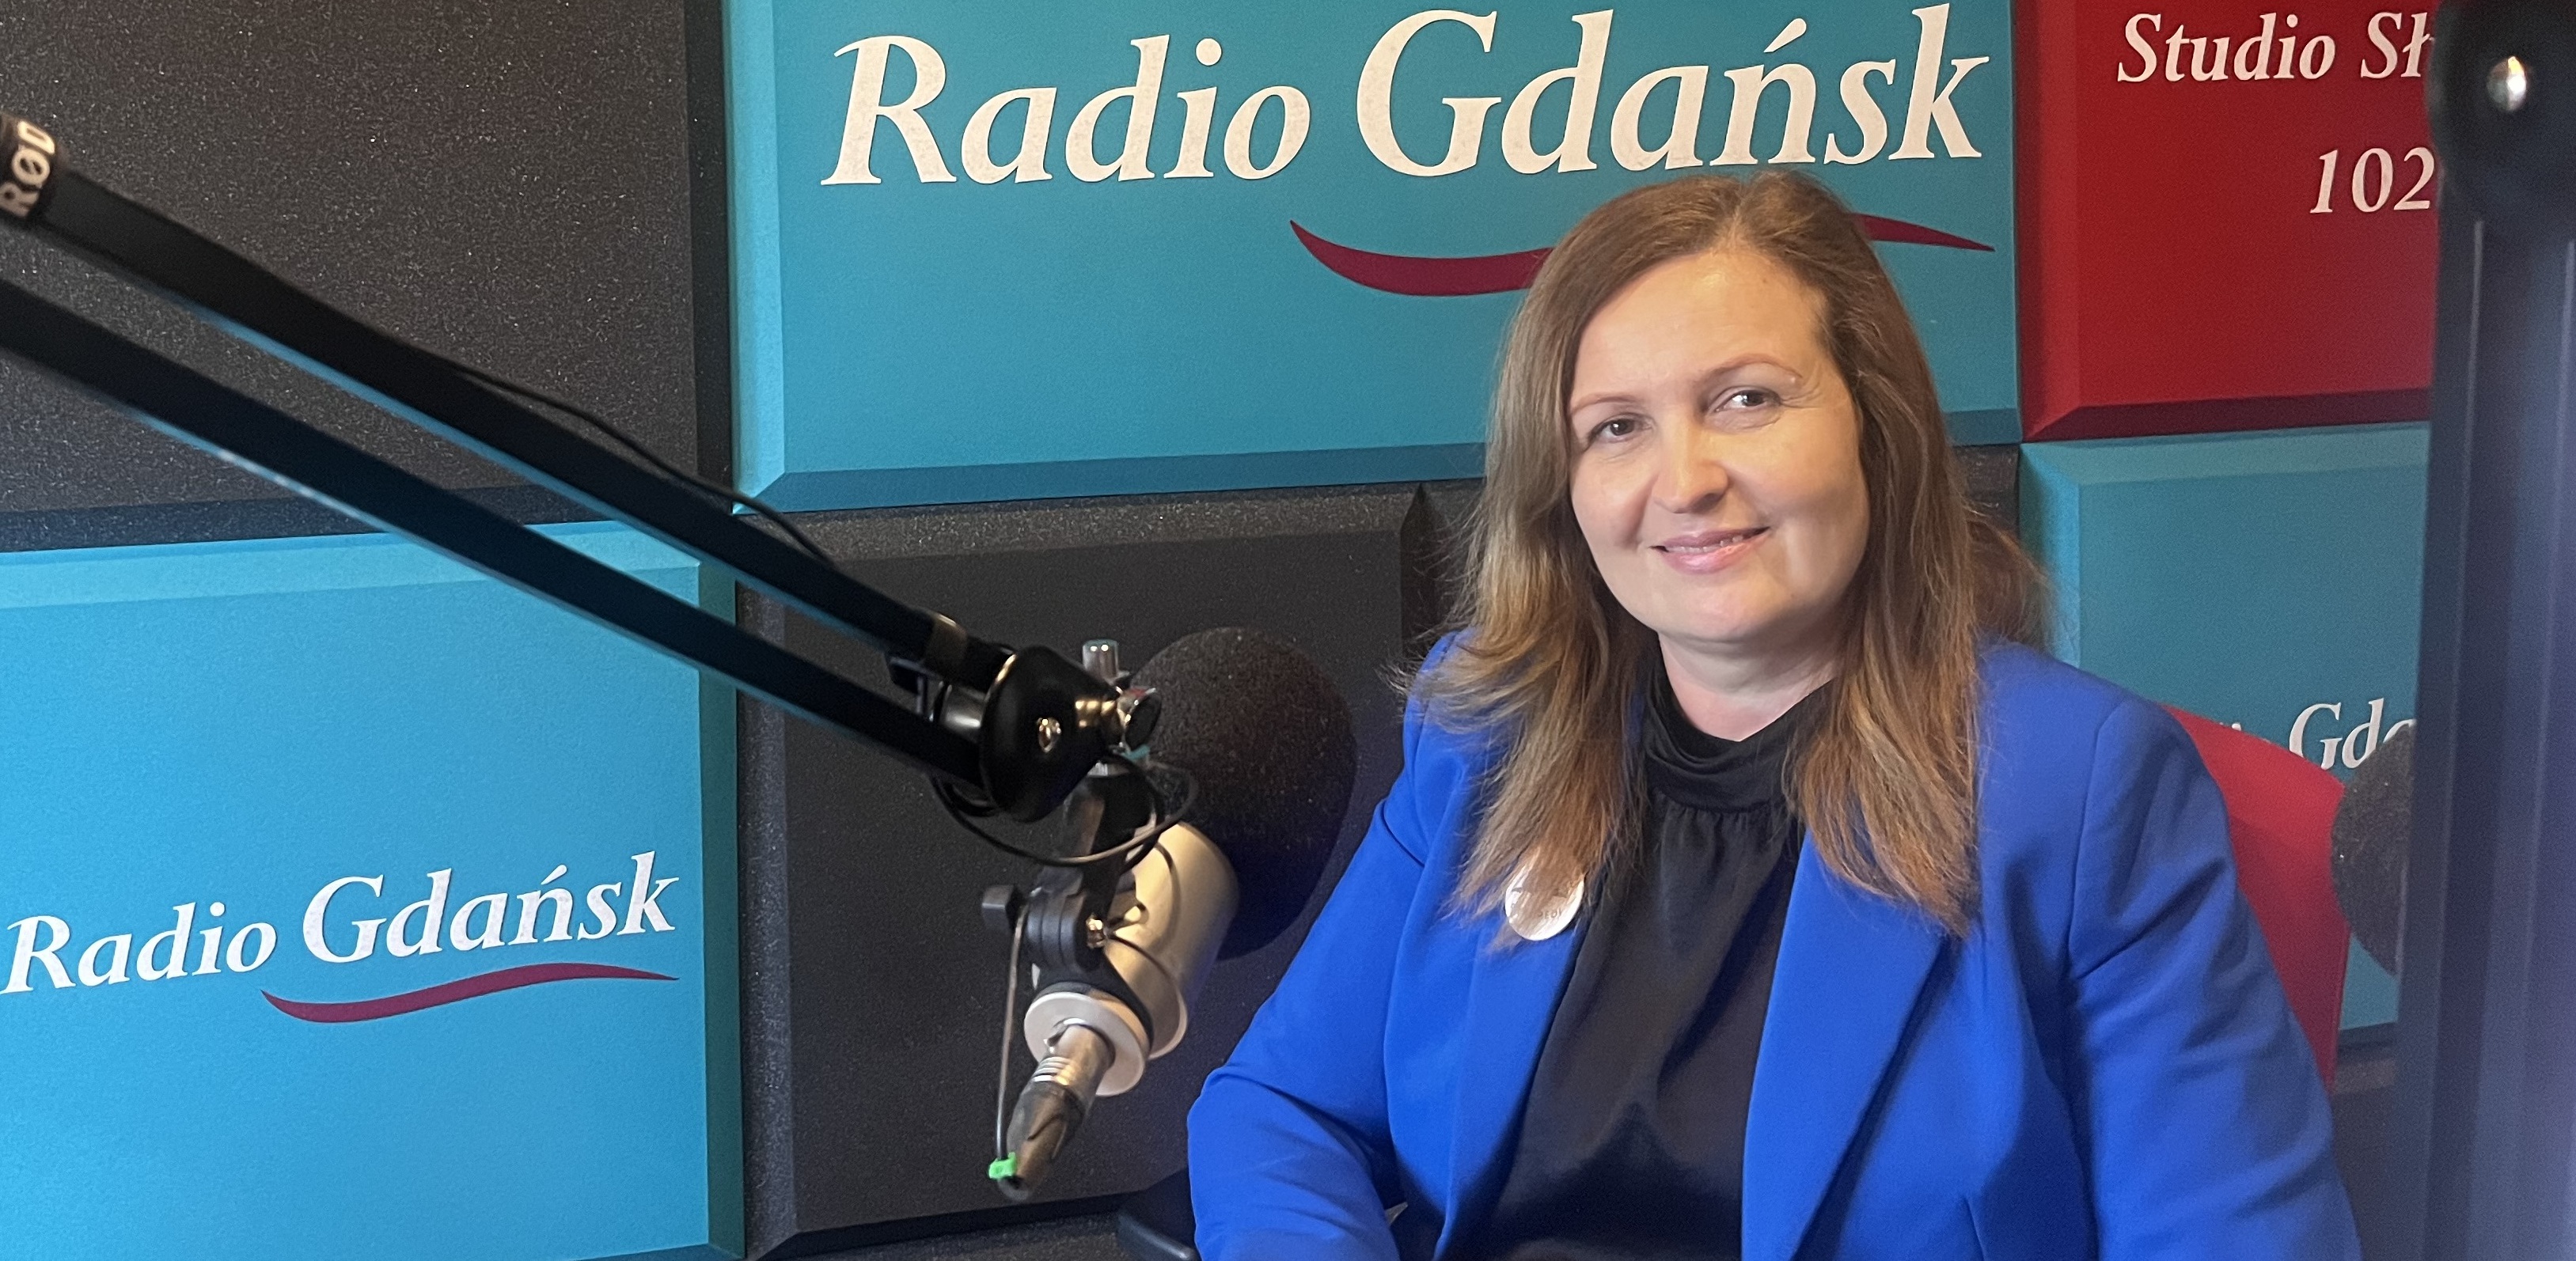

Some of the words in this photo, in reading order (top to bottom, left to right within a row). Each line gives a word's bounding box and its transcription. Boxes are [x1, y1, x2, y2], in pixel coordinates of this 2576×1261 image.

[820, 34, 1311, 186] Radio
[1356, 2, 1990, 177] Gdańsk
[2117, 12, 2335, 82] Studio
[2310, 147, 2435, 214] 102
[0, 902, 276, 994] Radio
[302, 850, 679, 964] Gdańsk
